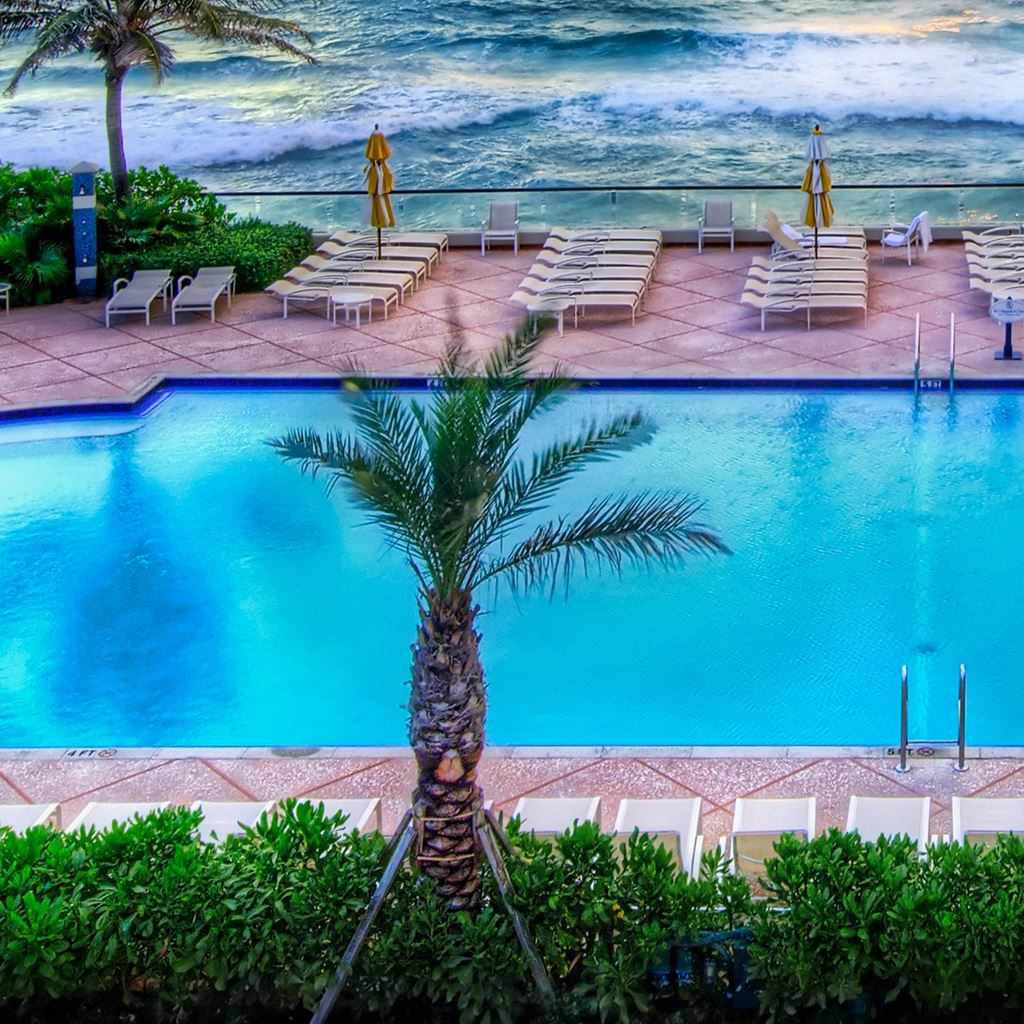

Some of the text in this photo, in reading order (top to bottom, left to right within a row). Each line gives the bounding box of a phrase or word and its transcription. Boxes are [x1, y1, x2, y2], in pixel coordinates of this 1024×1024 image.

[67, 749, 97, 757] 4 FT
[886, 748, 895, 756] 5
